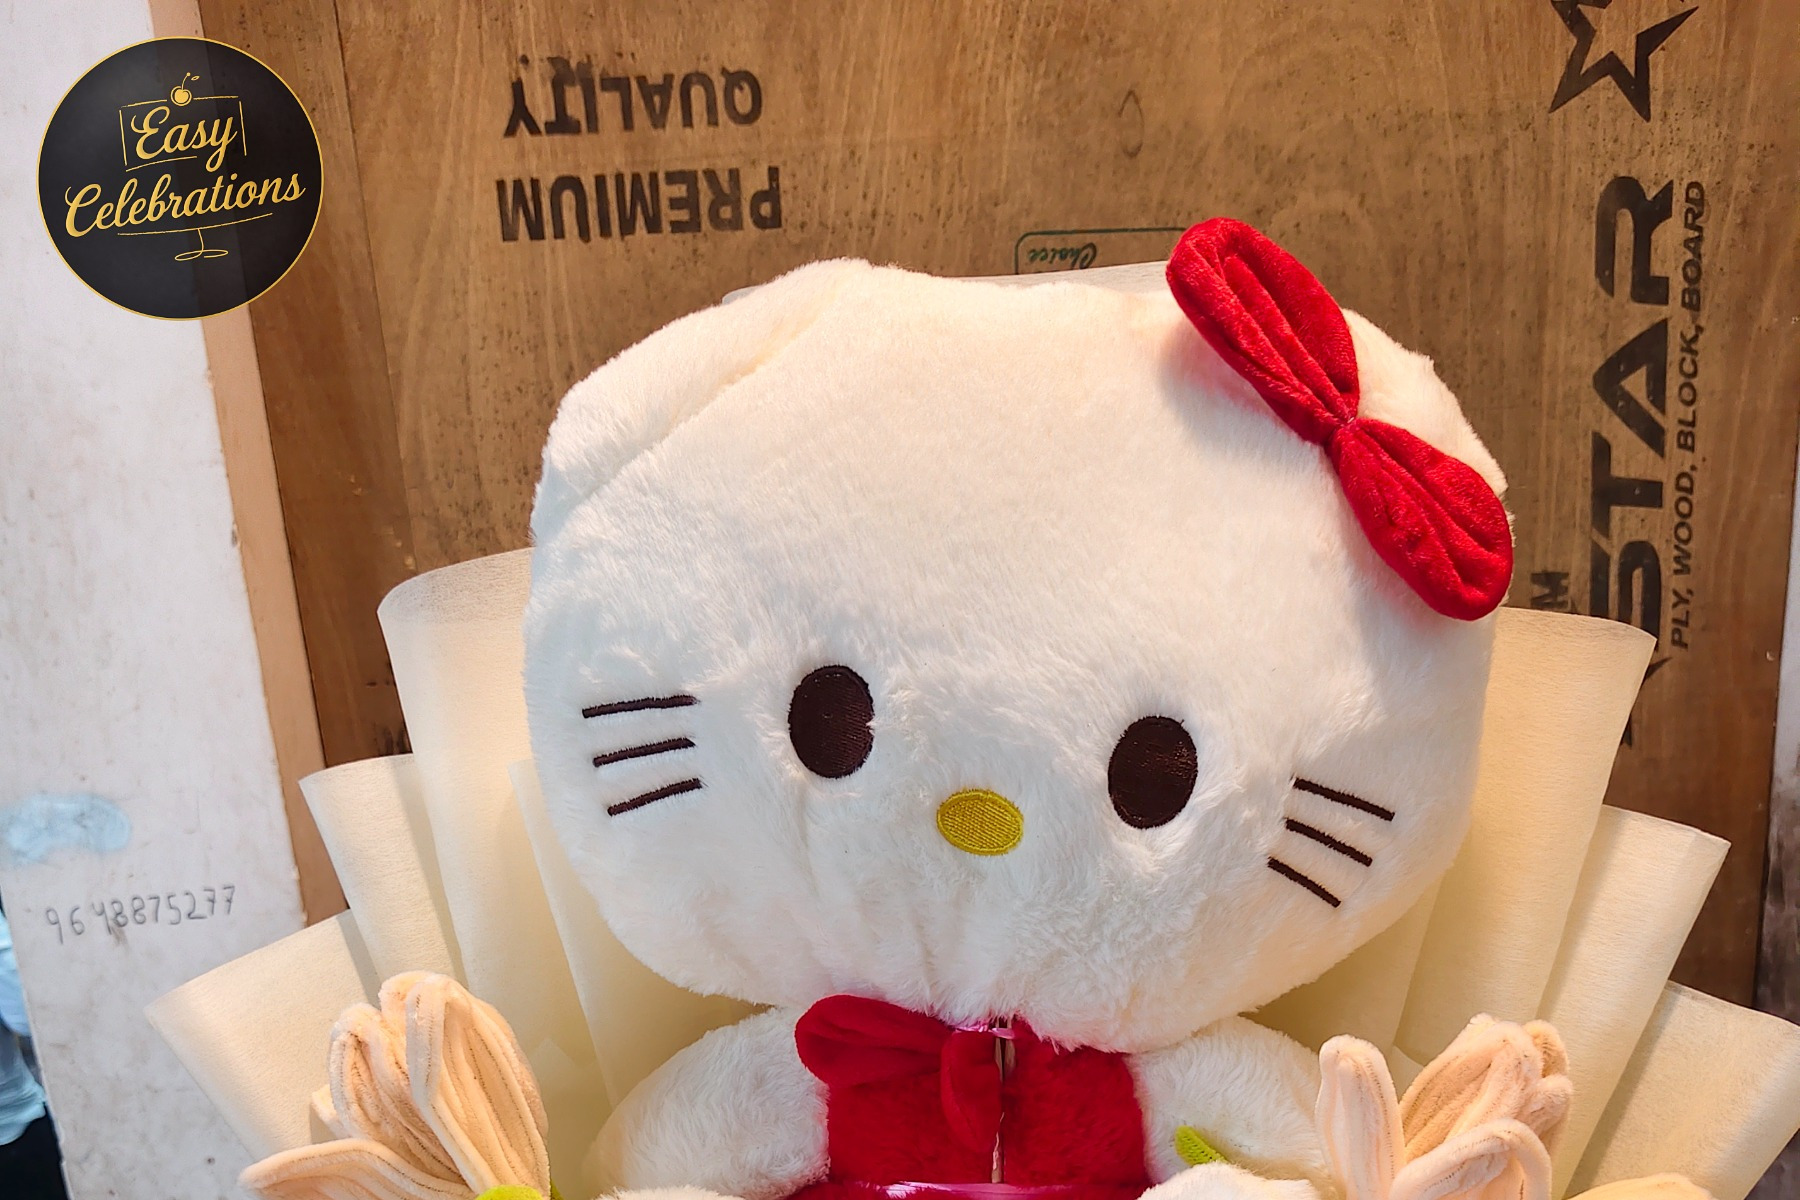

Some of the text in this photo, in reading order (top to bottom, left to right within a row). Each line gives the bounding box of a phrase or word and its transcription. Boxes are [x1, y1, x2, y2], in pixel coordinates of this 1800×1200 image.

[503, 62, 763, 137] QUALITY
[495, 165, 782, 243] PREMIUM
[1029, 242, 1097, 270] Choice
[1681, 181, 1705, 312] BOARD
[1588, 175, 1675, 651] STAR
[1676, 325, 1705, 454] BLOCK,
[1671, 588, 1695, 650] PLY,
